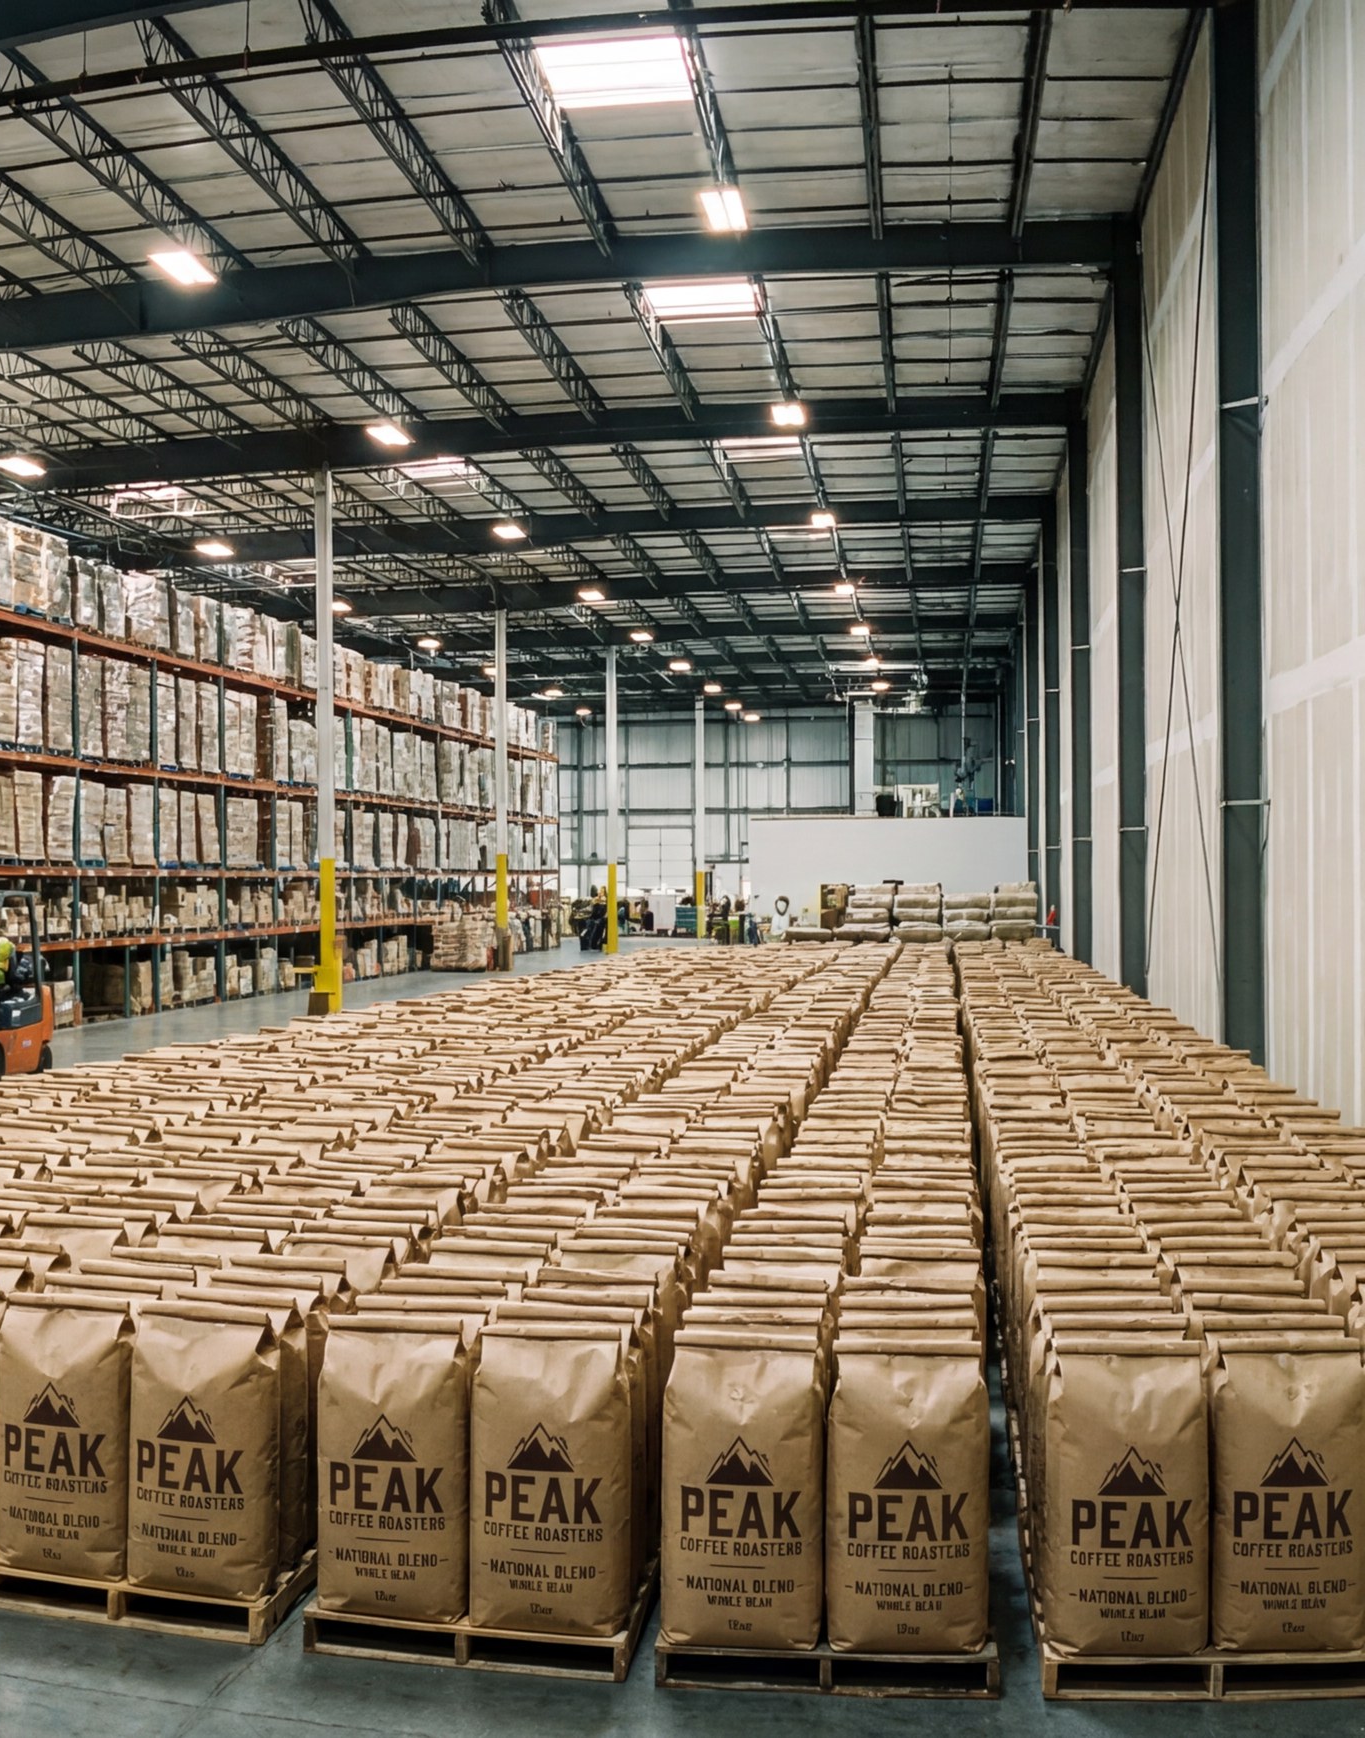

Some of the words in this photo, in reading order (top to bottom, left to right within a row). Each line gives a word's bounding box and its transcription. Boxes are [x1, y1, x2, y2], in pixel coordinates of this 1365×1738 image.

[5, 1424, 106, 1477] PEAK
[137, 1439, 245, 1494] PEAK
[330, 1461, 444, 1513] PEAK
[485, 1470, 603, 1524] PEAK
[329, 1510, 373, 1528] COFFEE
[681, 1485, 802, 1539] PEAK
[848, 1491, 969, 1542] PEAK
[1234, 1489, 1353, 1540] PEAK
[484, 1521, 529, 1540] COFFEE
[1072, 1499, 1192, 1548] PEAK
[680, 1536, 728, 1555] COFFEE
[847, 1543, 897, 1559] COFFEE
[1233, 1541, 1282, 1558] COFFEE
[1071, 1550, 1121, 1567] COFFEE
[686, 1575, 748, 1593] NATIONAL
[855, 1581, 919, 1598] NATIONAL
[1240, 1580, 1303, 1595] NATIONAL
[1308, 1579, 1346, 1594] BLEND
[1079, 1588, 1144, 1604] NATIONAL
